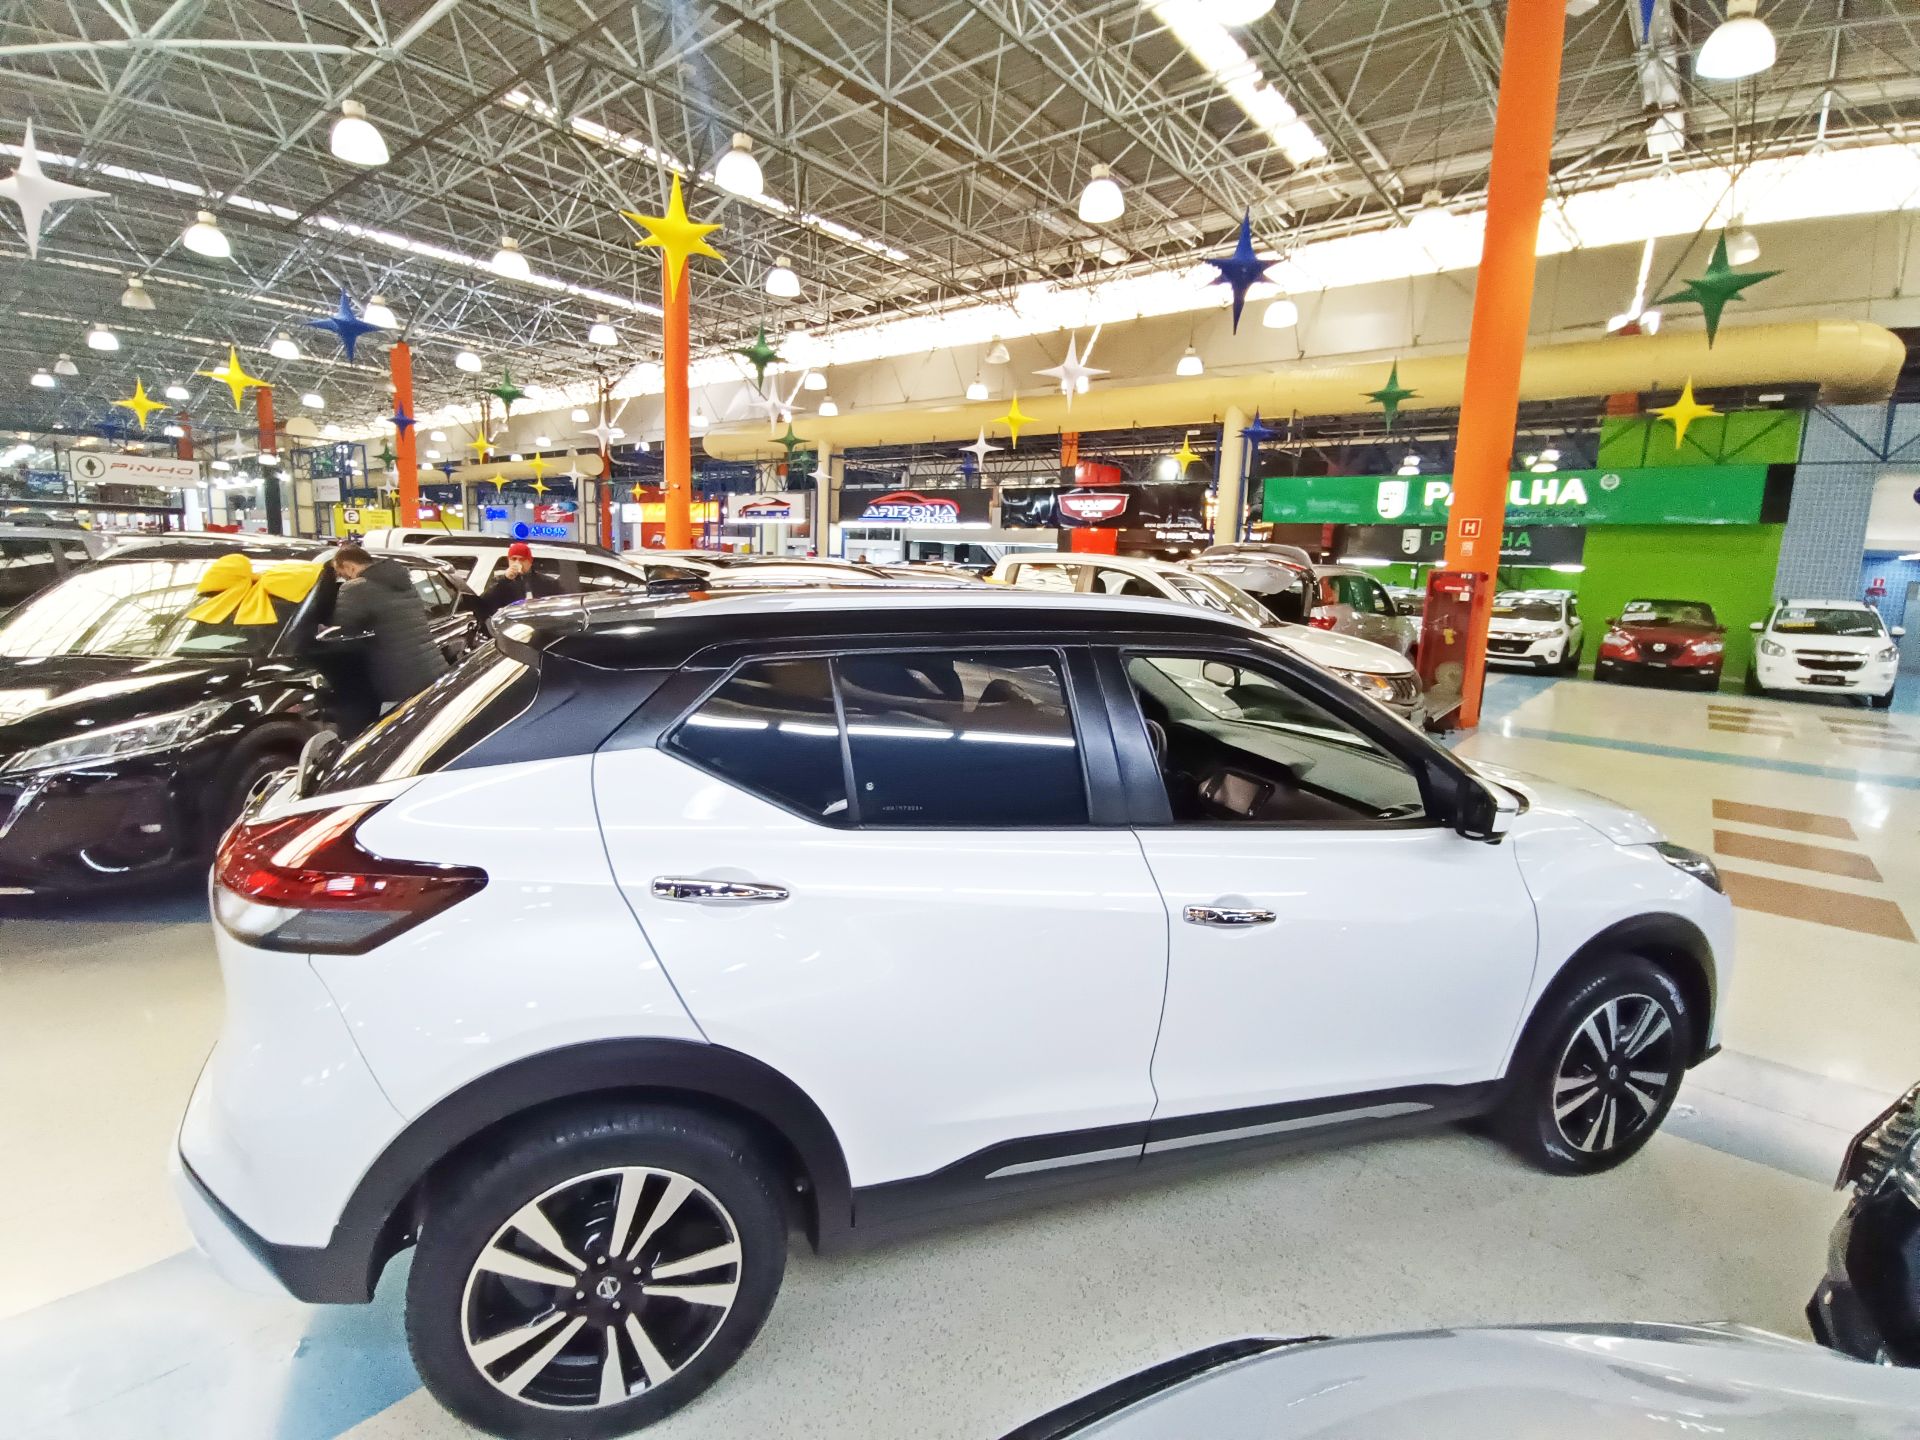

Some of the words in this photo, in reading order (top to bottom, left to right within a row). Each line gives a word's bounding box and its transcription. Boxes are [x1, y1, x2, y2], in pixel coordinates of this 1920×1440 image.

[347, 512, 356, 522] E
[862, 504, 957, 518] ARIZONA
[1464, 521, 1476, 534] H
